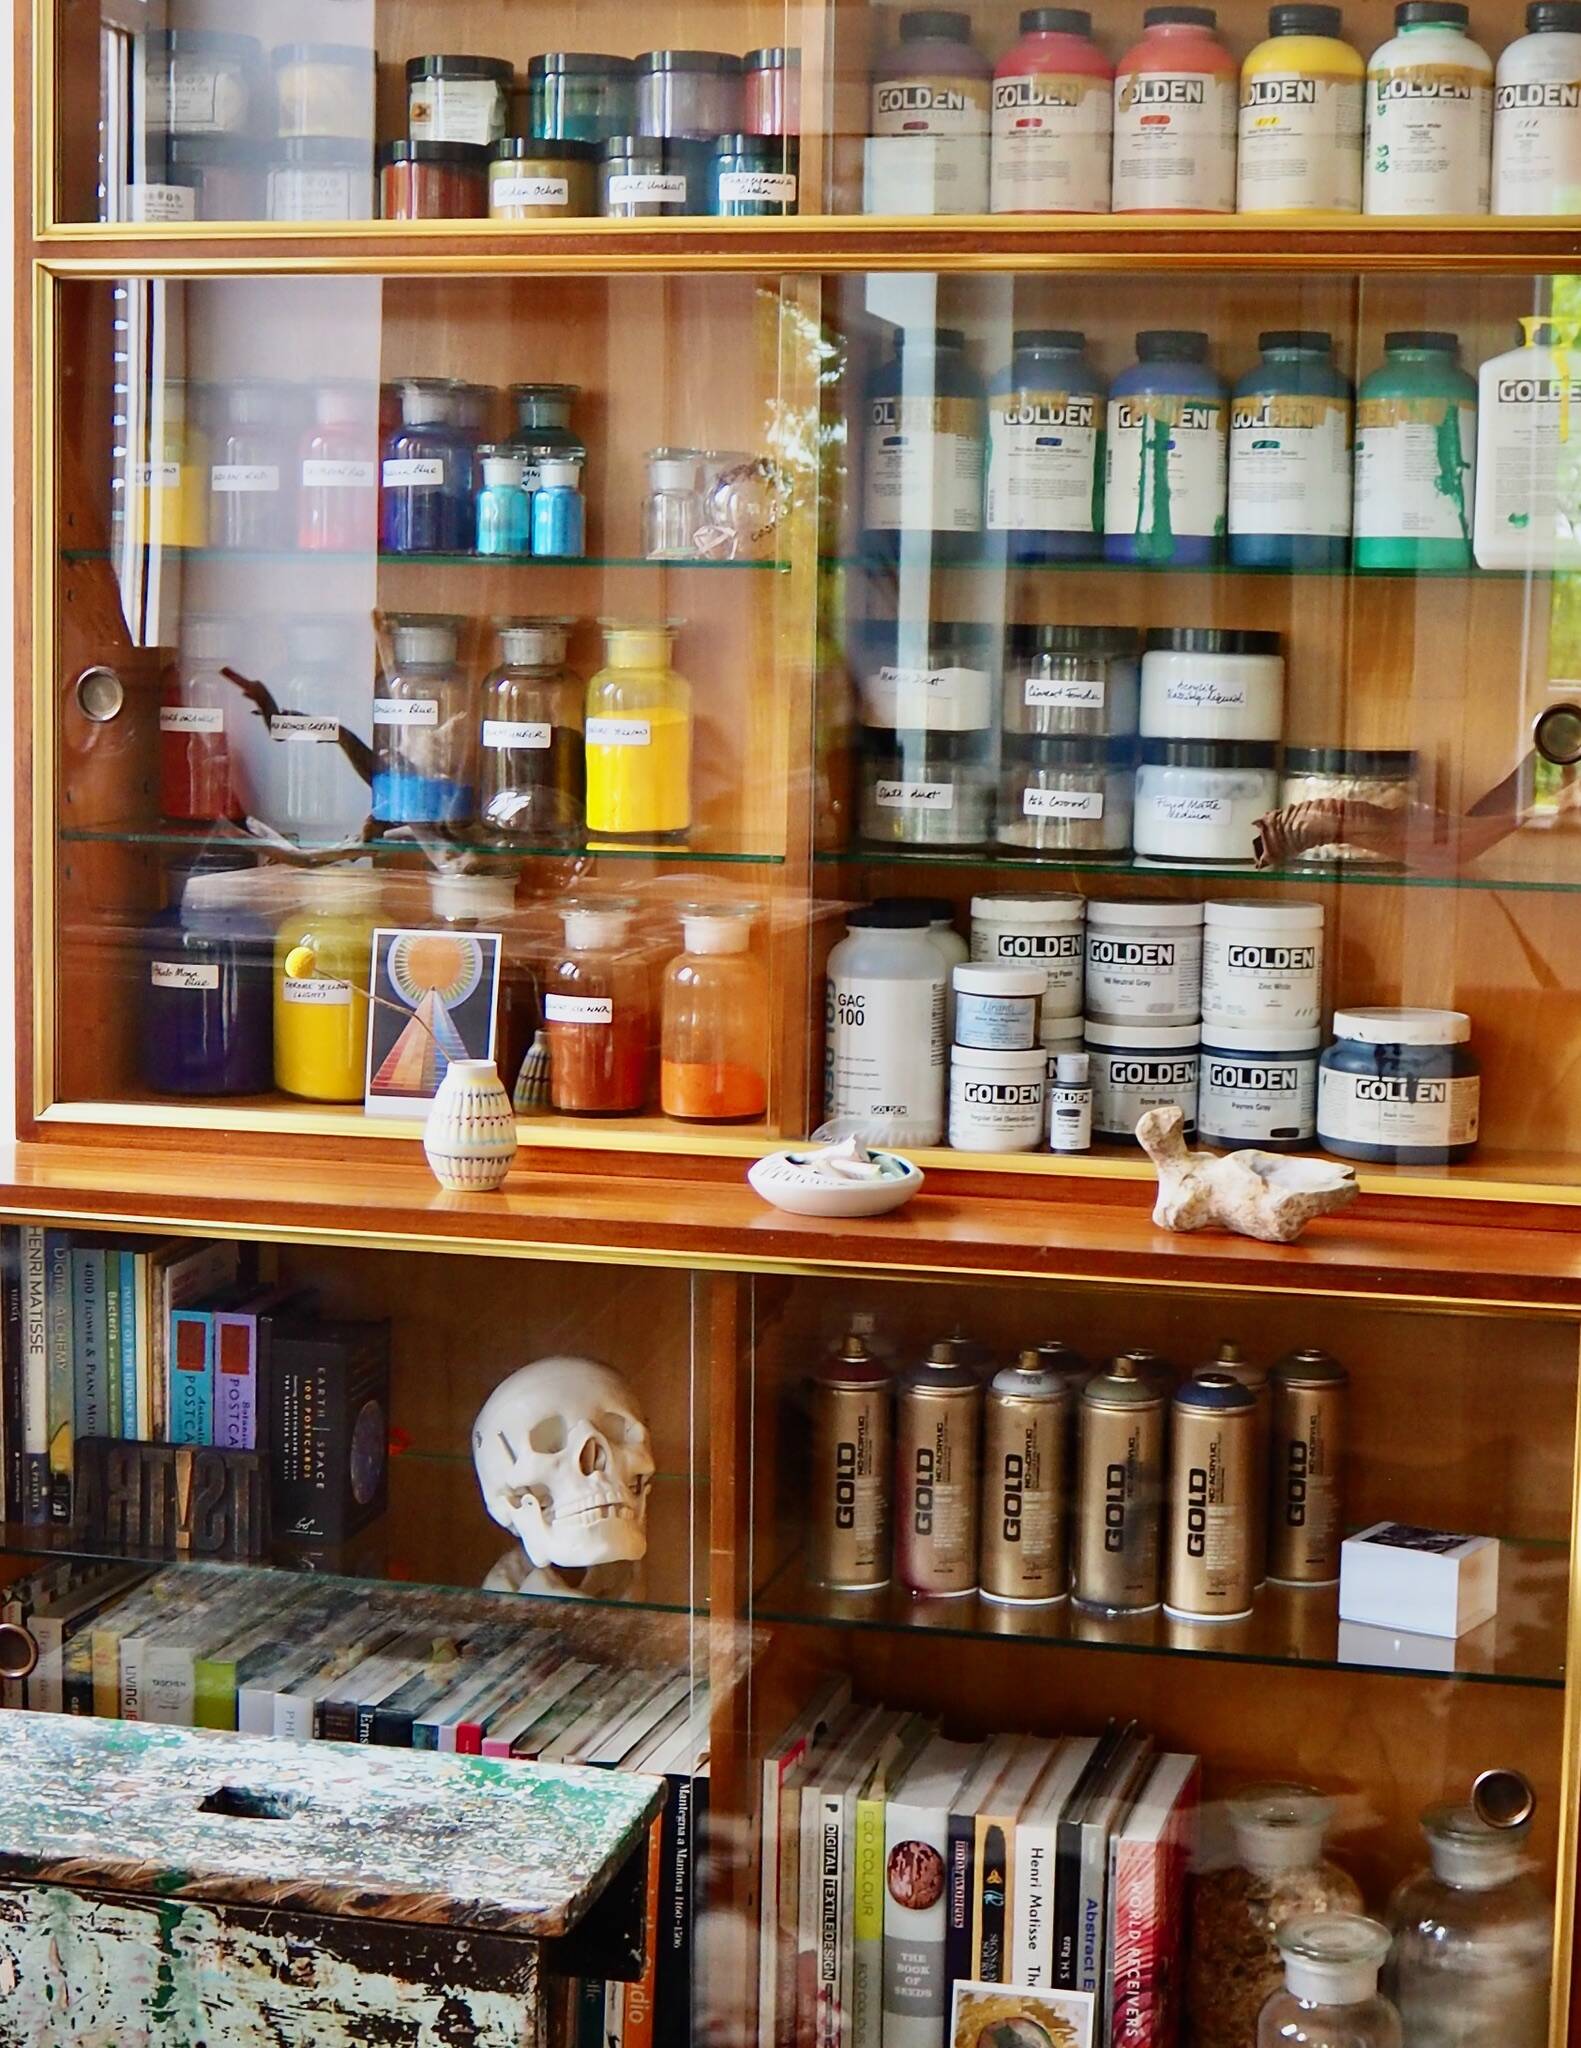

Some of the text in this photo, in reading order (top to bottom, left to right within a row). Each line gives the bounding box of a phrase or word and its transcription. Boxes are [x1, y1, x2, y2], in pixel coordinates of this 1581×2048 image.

[879, 87, 964, 113] GOLDEN
[1122, 80, 1204, 106] OLDEN
[1241, 80, 1315, 107] OLDEN
[999, 935, 1082, 958] GOLDEN
[1090, 940, 1174, 965] GOLDEN
[1228, 945, 1315, 969] GOLDEN
[838, 993, 866, 1008] GAC
[838, 1009, 866, 1026] 100
[965, 1082, 1041, 1104] GOLDEN
[1110, 1061, 1196, 1084] GOLDEN
[1211, 1064, 1298, 1089] GOLDEN
[28, 1226, 44, 1354] HENRI MATISSE
[107, 1290, 119, 1341] Bacteria
[303, 1379, 312, 1479] 100 POSTCARDS
[315, 1366, 326, 1490] EARTH SPACE
[836, 1442, 856, 1529] GOLD
[915, 1448, 934, 1536] GOLD
[1003, 1454, 1024, 1542] GOLD
[1286, 1440, 1308, 1527] GOLD
[1104, 1463, 1126, 1553] GOLD
[1187, 1468, 1208, 1557] GOLD
[125, 1665, 138, 1706] LIVING
[676, 1782, 690, 1836] Mantegna
[675, 1847, 688, 1893] Mantova
[862, 1811, 874, 1918] ECO COLOUR
[1030, 1847, 1044, 1888] Henri
[822, 1824, 838, 1981] DIGITAL TEXTILE DESIGN
[1028, 1894, 1042, 1950] Matisse
[1061, 1935, 1071, 1958] Raza
[1085, 1897, 1098, 1972] Abstract
[896, 1964, 931, 1976] BOOK
[901, 1953, 927, 1962] THE
[1126, 1881, 1143, 2037] WORLD RECEIVERS
[894, 1987, 932, 1998] SEEDS
[904, 1976, 922, 1985] OF
